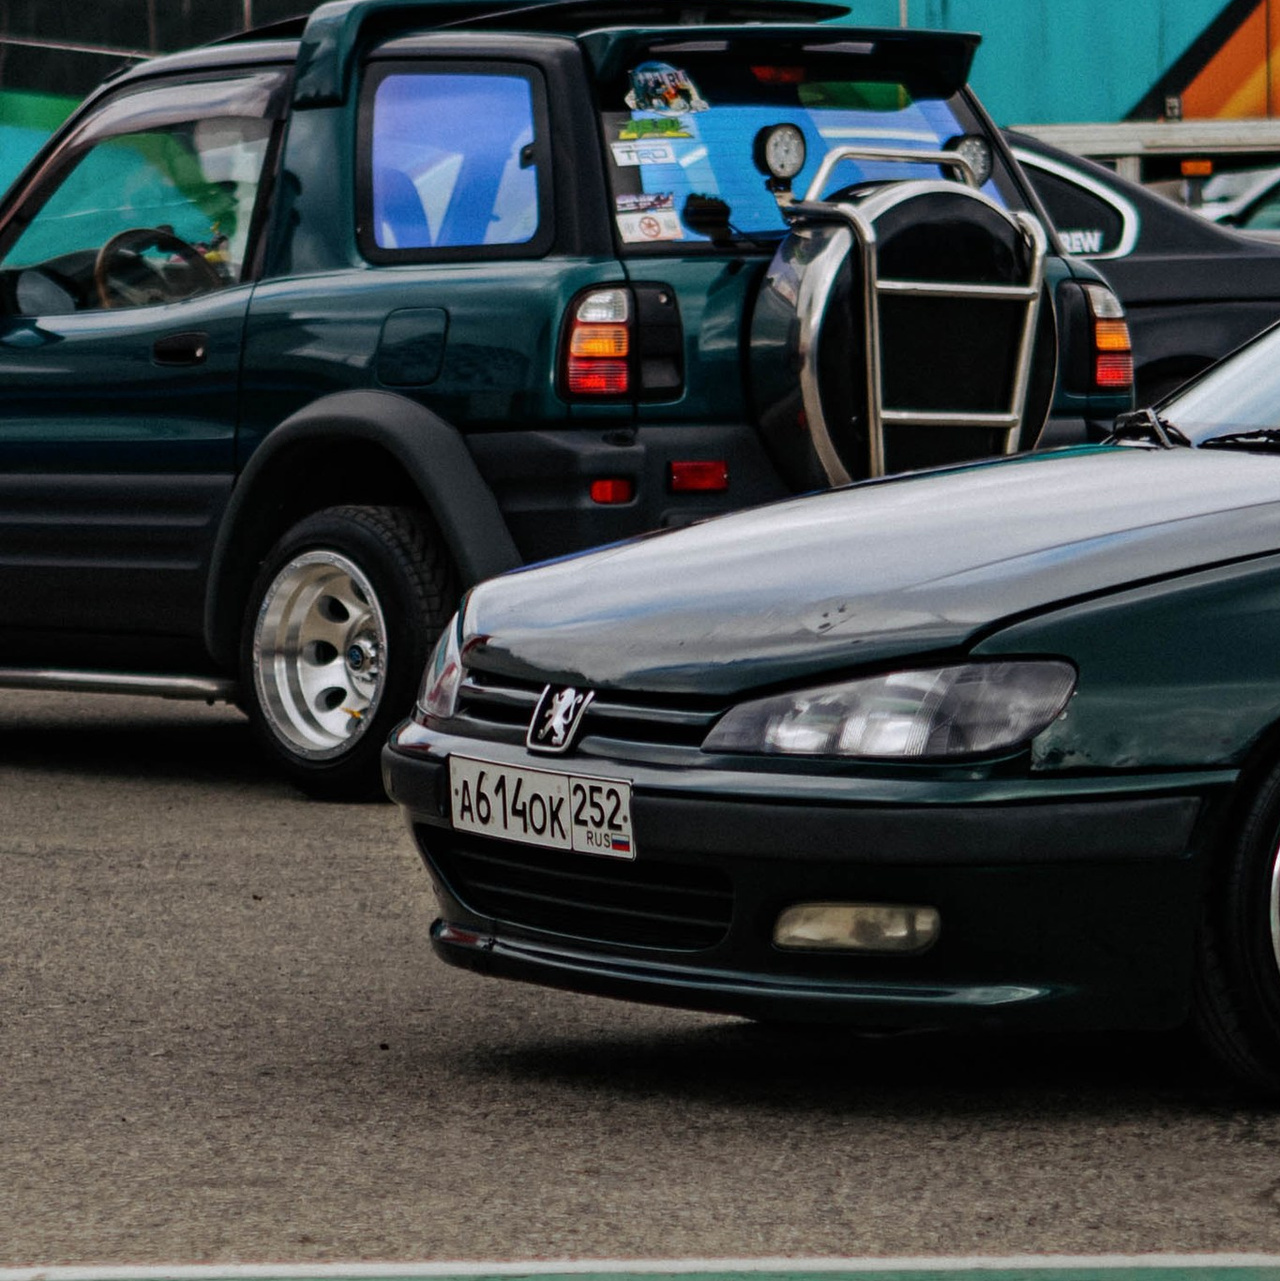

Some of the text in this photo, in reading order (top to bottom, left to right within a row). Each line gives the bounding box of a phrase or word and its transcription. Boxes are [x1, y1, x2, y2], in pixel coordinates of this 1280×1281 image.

[460, 770, 623, 840] А614ОК 252
[586, 830, 611, 847] RUS
